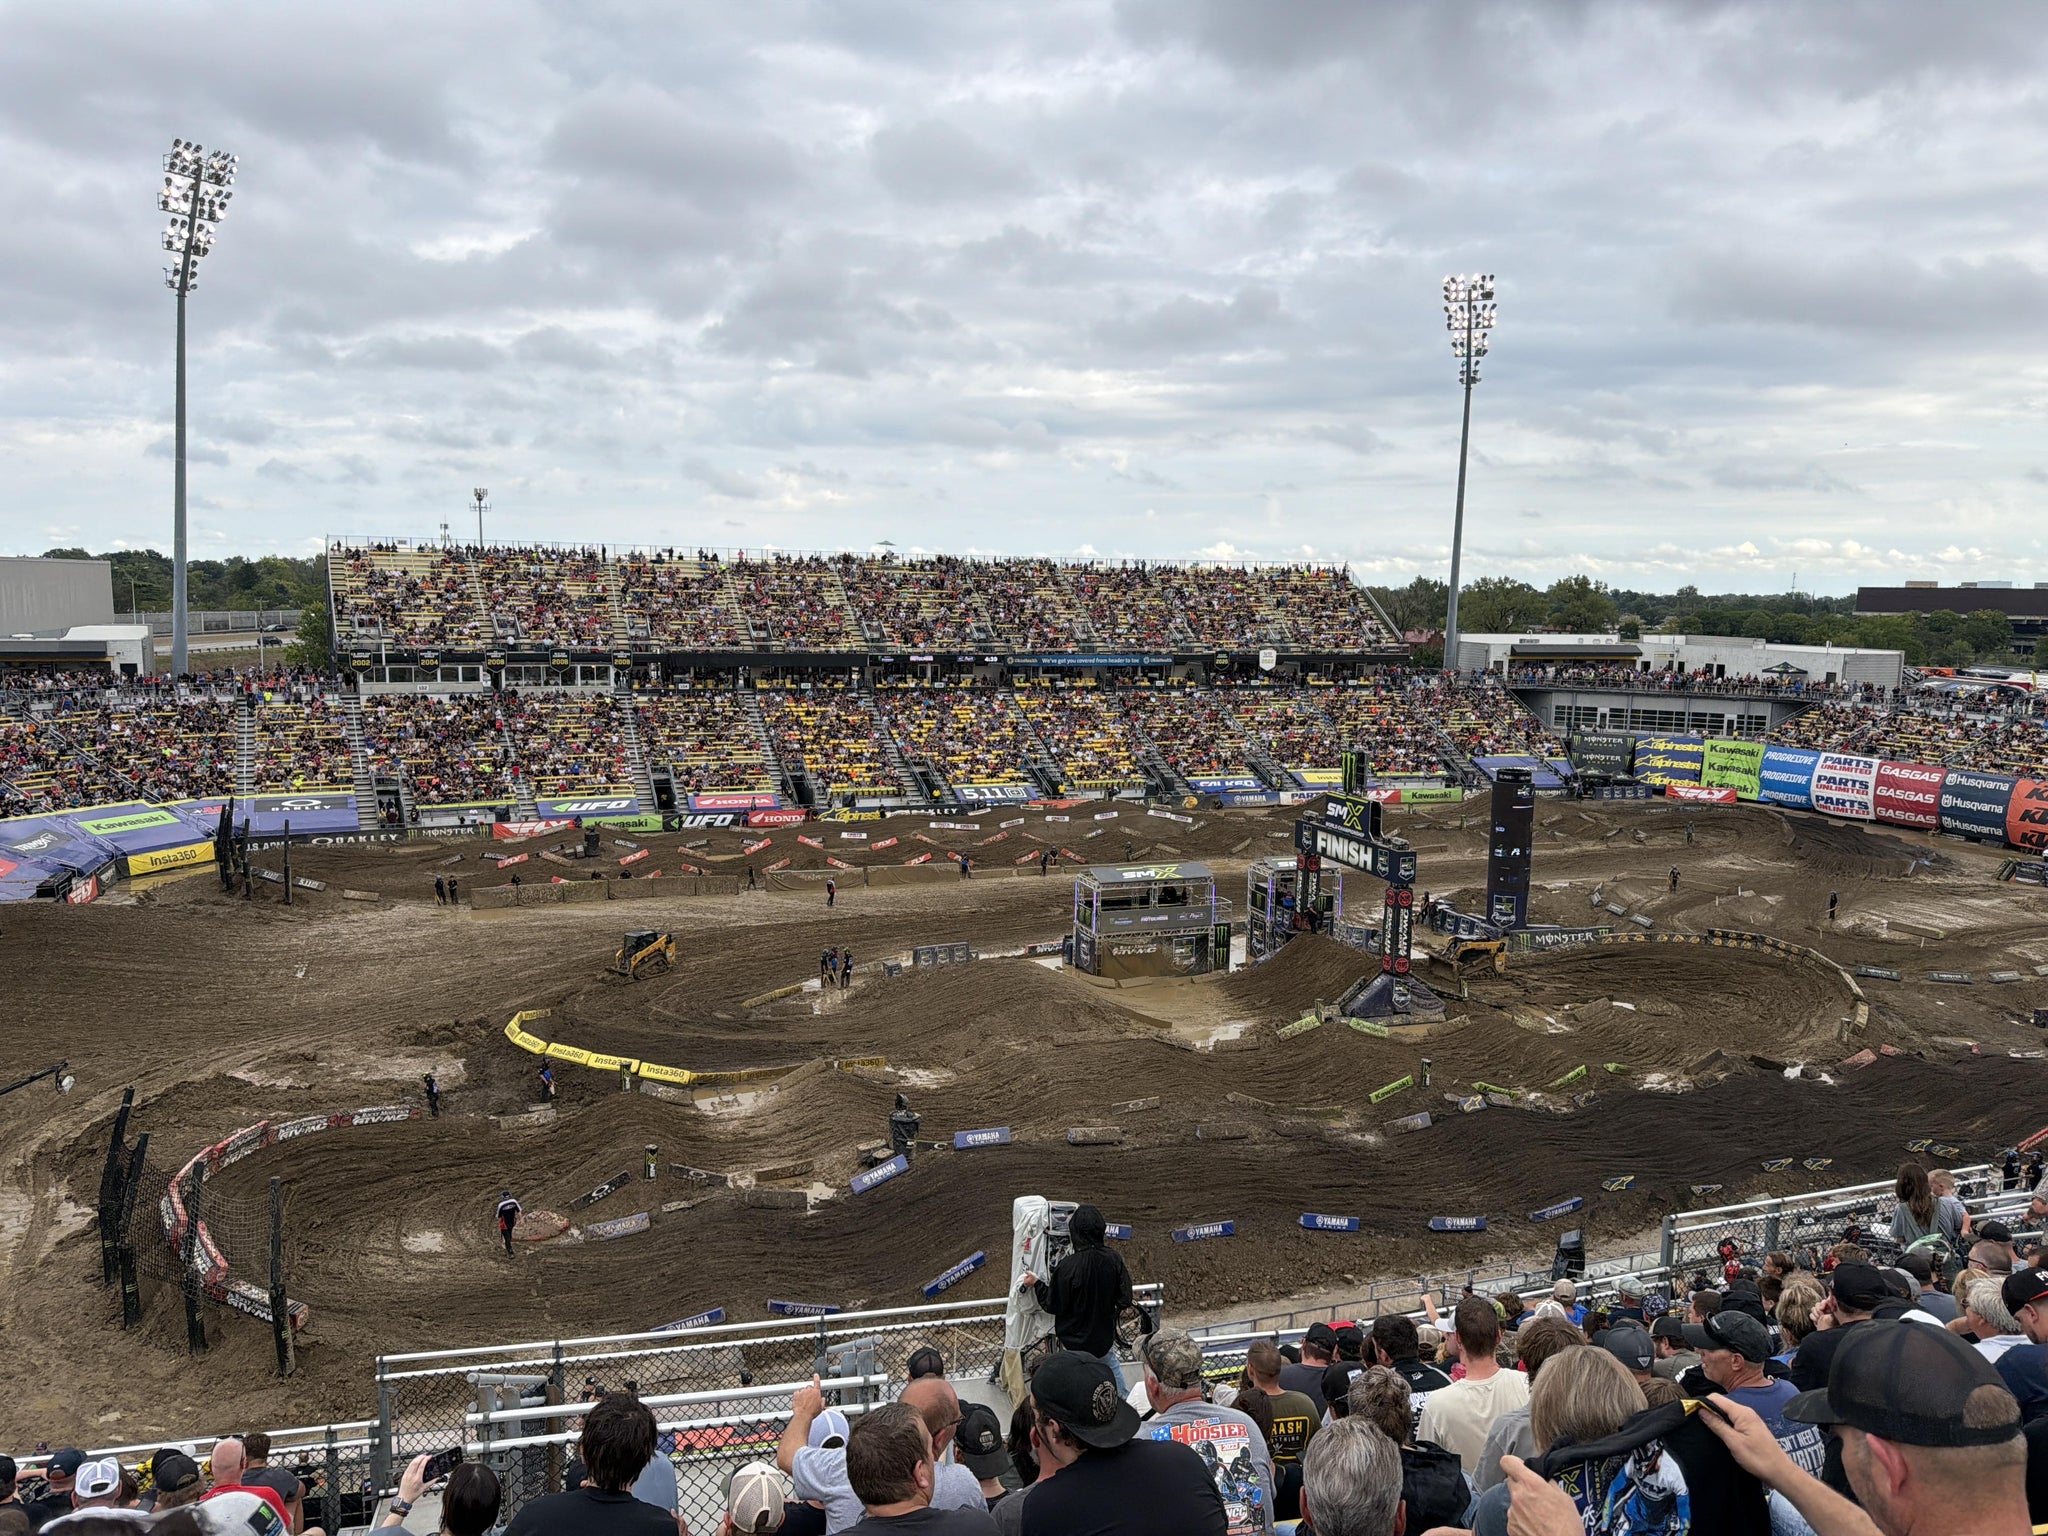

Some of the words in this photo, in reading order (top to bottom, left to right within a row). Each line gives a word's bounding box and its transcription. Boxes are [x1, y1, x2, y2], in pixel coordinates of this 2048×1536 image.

[1583, 736, 1623, 745] MONSTER
[1652, 740, 1704, 752] alpinestars
[1710, 744, 1760, 758] Kawasaki
[1582, 754, 1621, 762] MONSTER
[1650, 758, 1701, 770] alpinestars
[1764, 751, 1817, 765] PROGRESSIVE
[1823, 756, 1873, 769] PARTS
[1708, 761, 1756, 777] Kawasaki
[1820, 764, 1872, 775] UNLIMITED
[1880, 765, 1942, 783] GASGAS
[1760, 770, 1810, 785] PROGRESSIVE
[1816, 775, 1869, 790] PARTS
[1956, 775, 2009, 791] Husqvarna
[963, 788, 1006, 799] 5.11
[1412, 791, 1451, 799] Kawasaki
[1760, 789, 1808, 804] PROGRESSIVE
[1816, 784, 1868, 796] UNLIMITED
[1876, 786, 1935, 804] GASGAS
[1240, 795, 1266, 803] YAMAHA
[1815, 795, 1869, 810] PARTS
[1952, 797, 2003, 814] Husqvarna
[568, 800, 631, 812] UFO
[1817, 804, 1870, 816] UNLIMITED
[683, 814, 734, 828] UFO
[837, 810, 880, 822] alpinest
[1326, 802, 1365, 830] SMX
[1876, 807, 1937, 824] GASGAS
[91, 814, 167, 831] Kawasaki
[1952, 819, 2003, 836] Husqvarna
[422, 827, 475, 836] MONSTER
[336, 834, 397, 844] OAKLEY
[1316, 829, 1374, 872] FINISH
[150, 849, 197, 867] Insta360
[1122, 866, 1183, 880] SMX
[1536, 932, 1594, 945] MONSTER
[552, 1046, 584, 1059] Insta360
[646, 1065, 685, 1078] Insta360
[1374, 1080, 1410, 1100] Kawasaki
[974, 1132, 1000, 1142] YAMAHA
[869, 1162, 897, 1180] YAMAHA
[1551, 1204, 1573, 1216] YAMAHA
[1323, 1217, 1349, 1226] YAMAHA
[1452, 1217, 1477, 1226] YAMAHA
[1105, 1226, 1119, 1235] AHA
[1195, 1225, 1223, 1235] YAMAHA
[947, 1263, 975, 1285] YAMAHA
[2035, 1271, 2048, 1282] FO
[794, 1305, 826, 1315] YAMAHA
[675, 1315, 710, 1330] YAMAHA
[1171, 1424, 1248, 1443] HOOSIER
[1272, 1421, 1303, 1435] RASH
[1796, 1428, 1816, 1447] NEED
